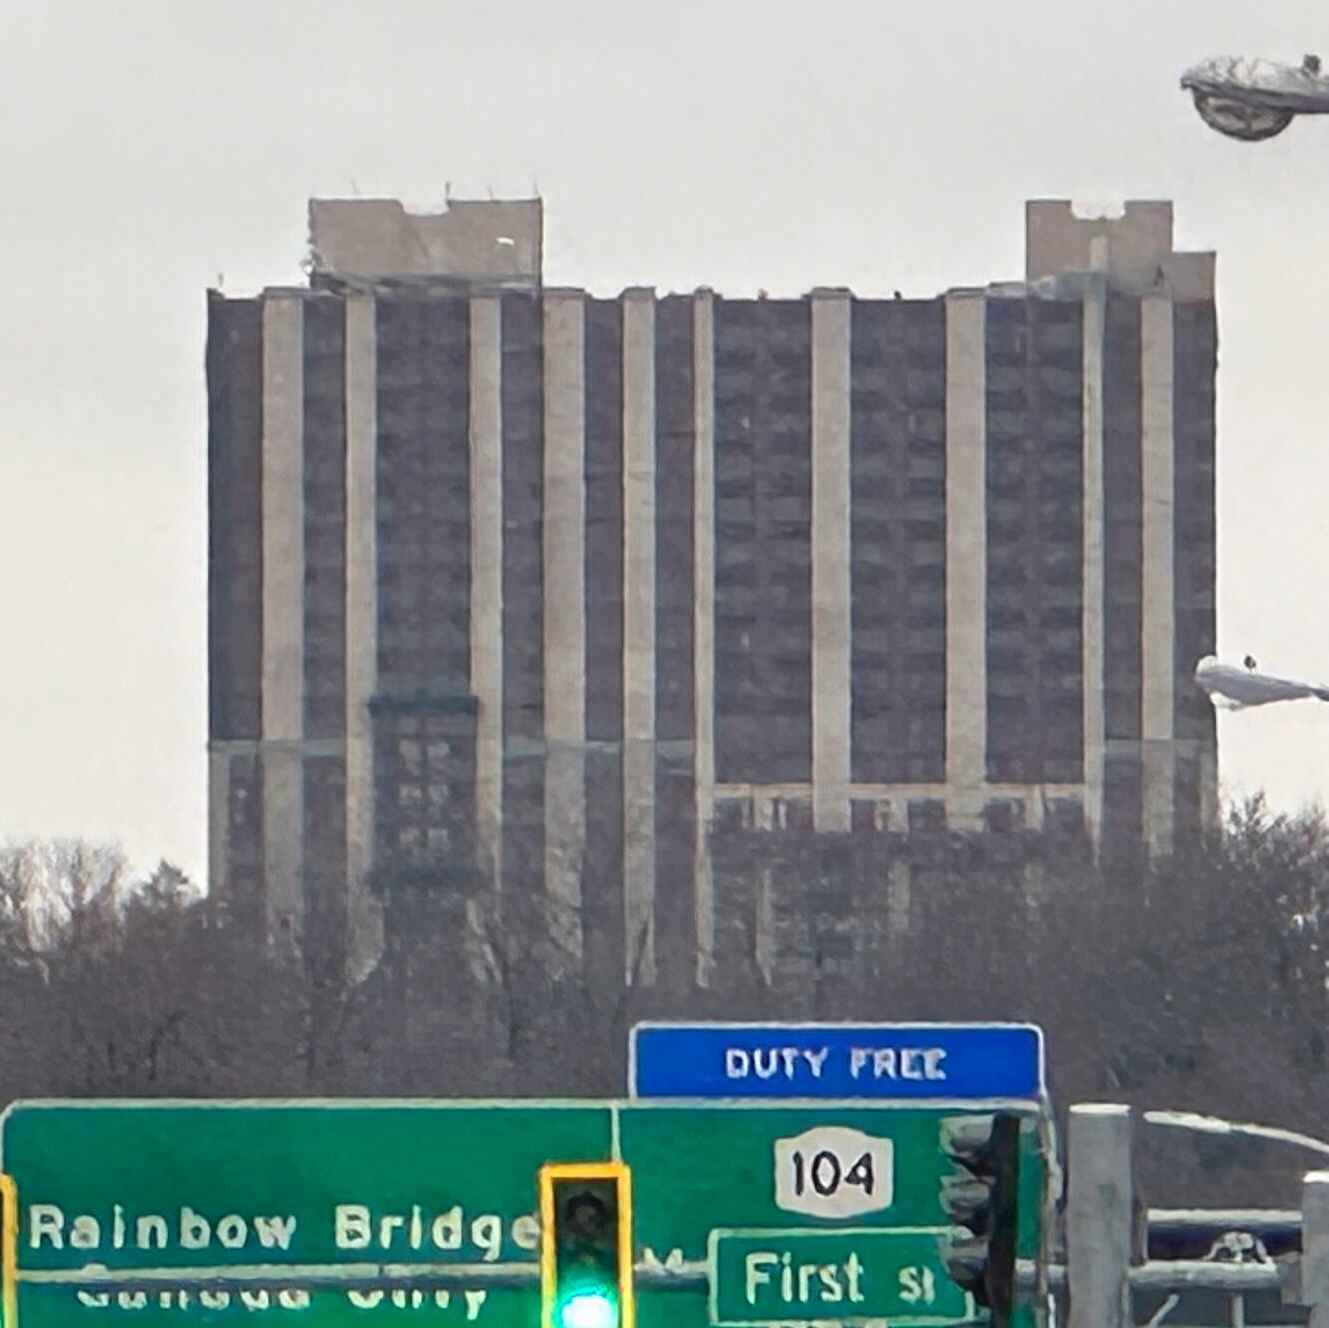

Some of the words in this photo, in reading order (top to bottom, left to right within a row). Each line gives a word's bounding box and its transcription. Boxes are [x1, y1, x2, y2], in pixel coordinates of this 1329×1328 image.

[725, 1047, 828, 1079] DUTY
[849, 1047, 947, 1080] FREE
[790, 1150, 875, 1197] 104
[28, 1204, 296, 1250] Rainbow
[335, 1204, 542, 1262] Bridge
[745, 1252, 865, 1305] First
